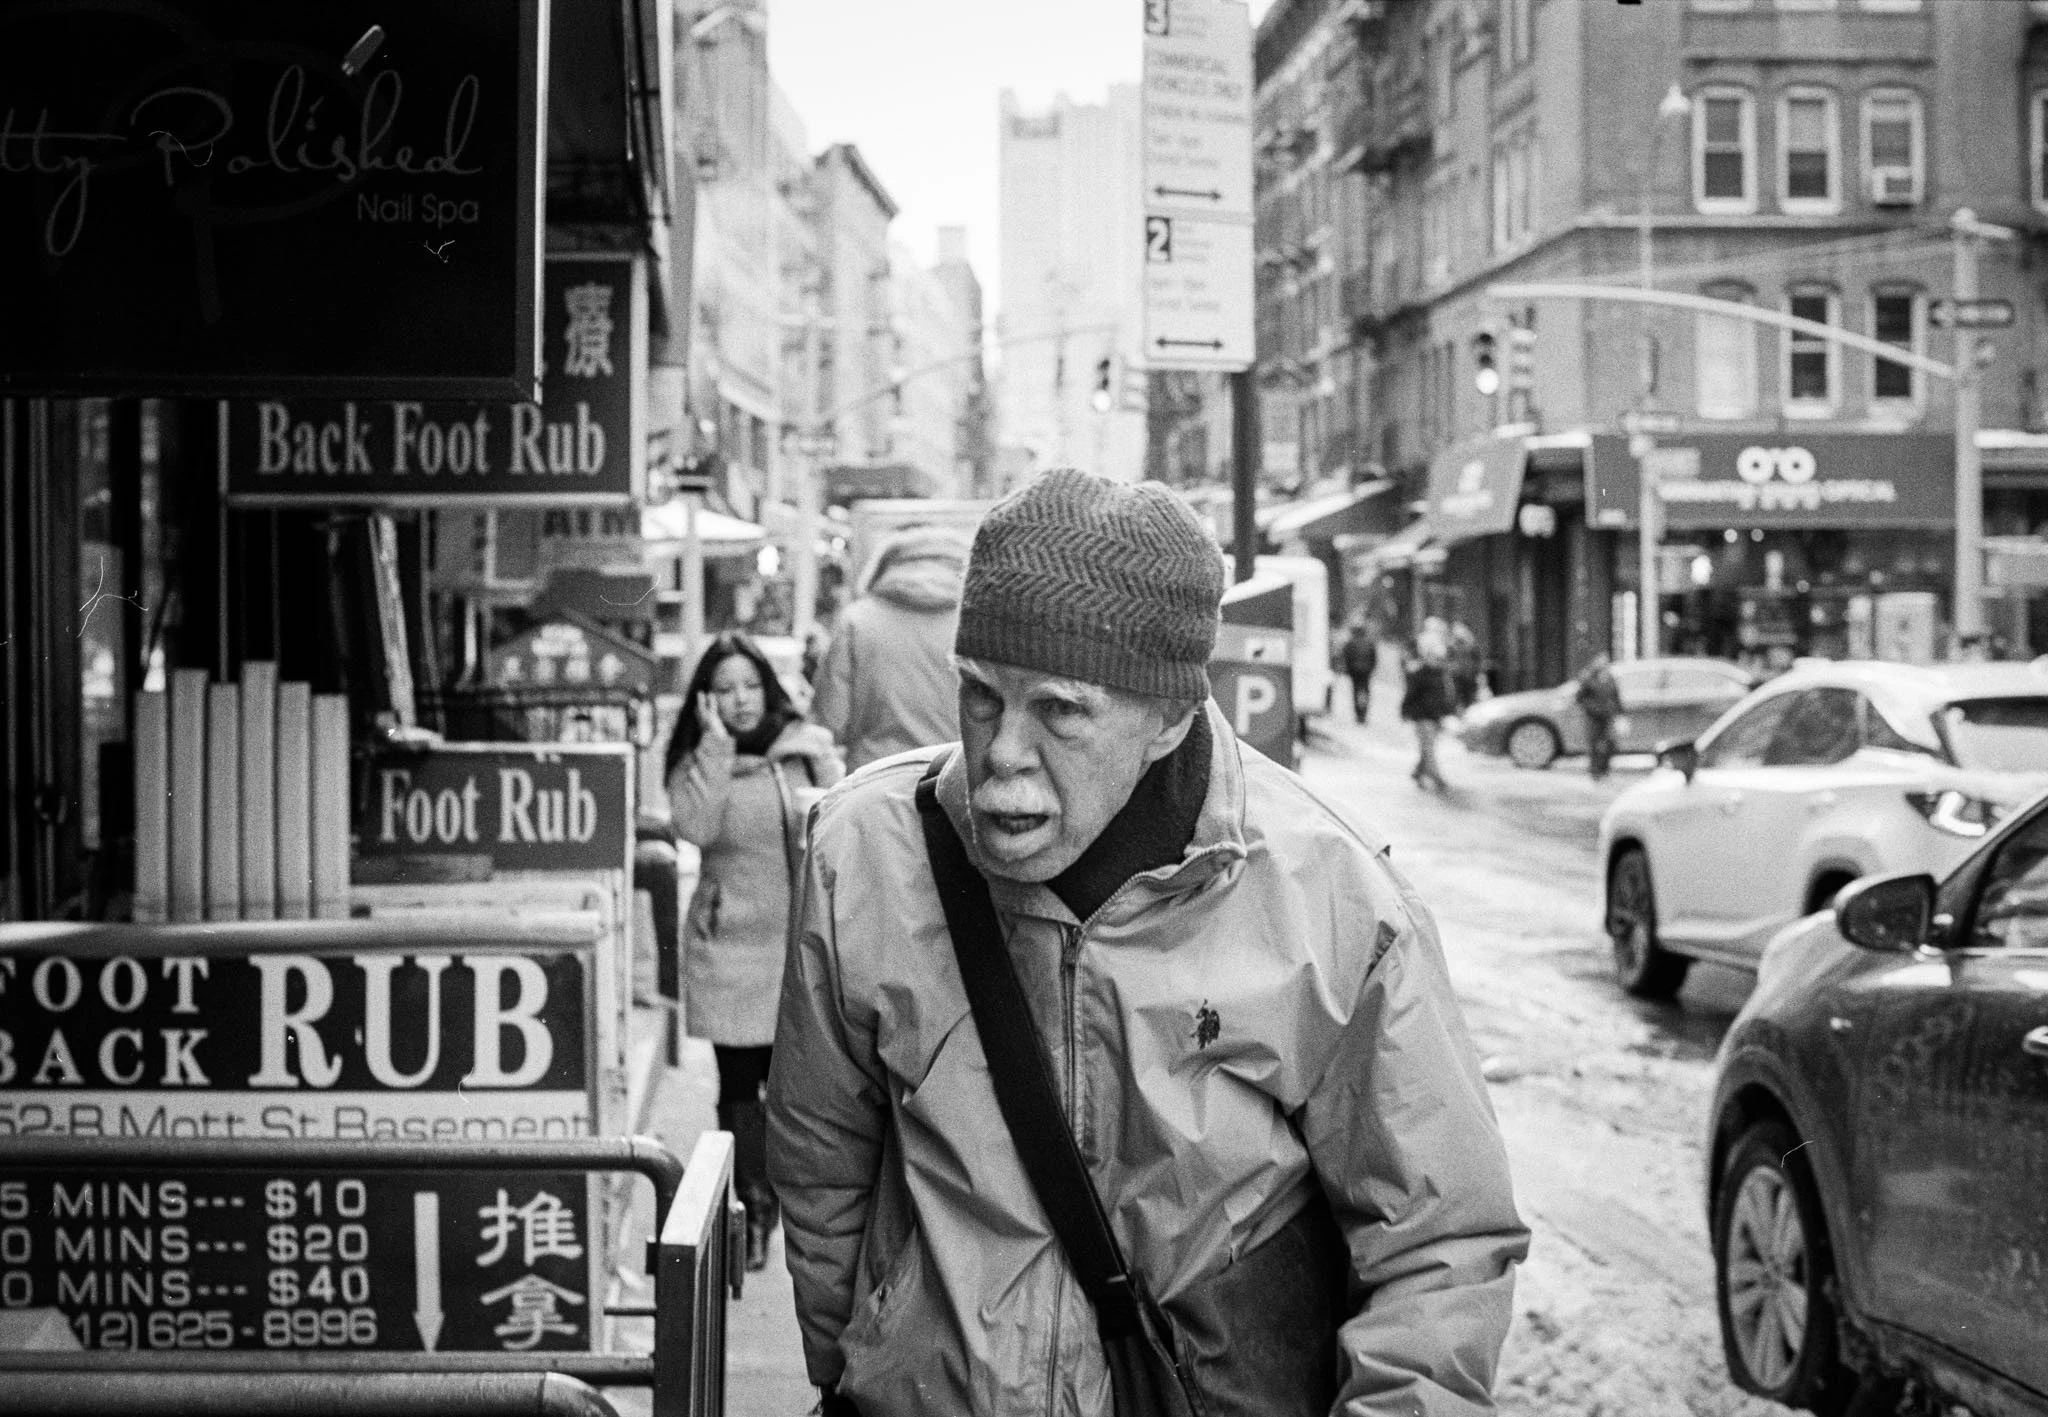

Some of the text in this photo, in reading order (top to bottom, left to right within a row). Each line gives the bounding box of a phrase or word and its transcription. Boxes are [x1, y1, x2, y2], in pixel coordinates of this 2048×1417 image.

[130, 62, 483, 187] Polished
[357, 193, 480, 228] Nail Spa
[1148, 219, 1168, 260] 2
[258, 402, 606, 476] Back Foot Rub
[1235, 675, 1277, 736] P
[380, 768, 598, 844] Foot Rub
[248, 954, 555, 1088] RUB
[119, 1105, 246, 1138] Mott
[260, 1105, 319, 1139] St
[333, 1106, 591, 1141] Basement
[264, 1179, 367, 1219] $10
[266, 1224, 369, 1263] $20
[477, 1188, 585, 1350] 推拿
[268, 1265, 370, 1307] $40
